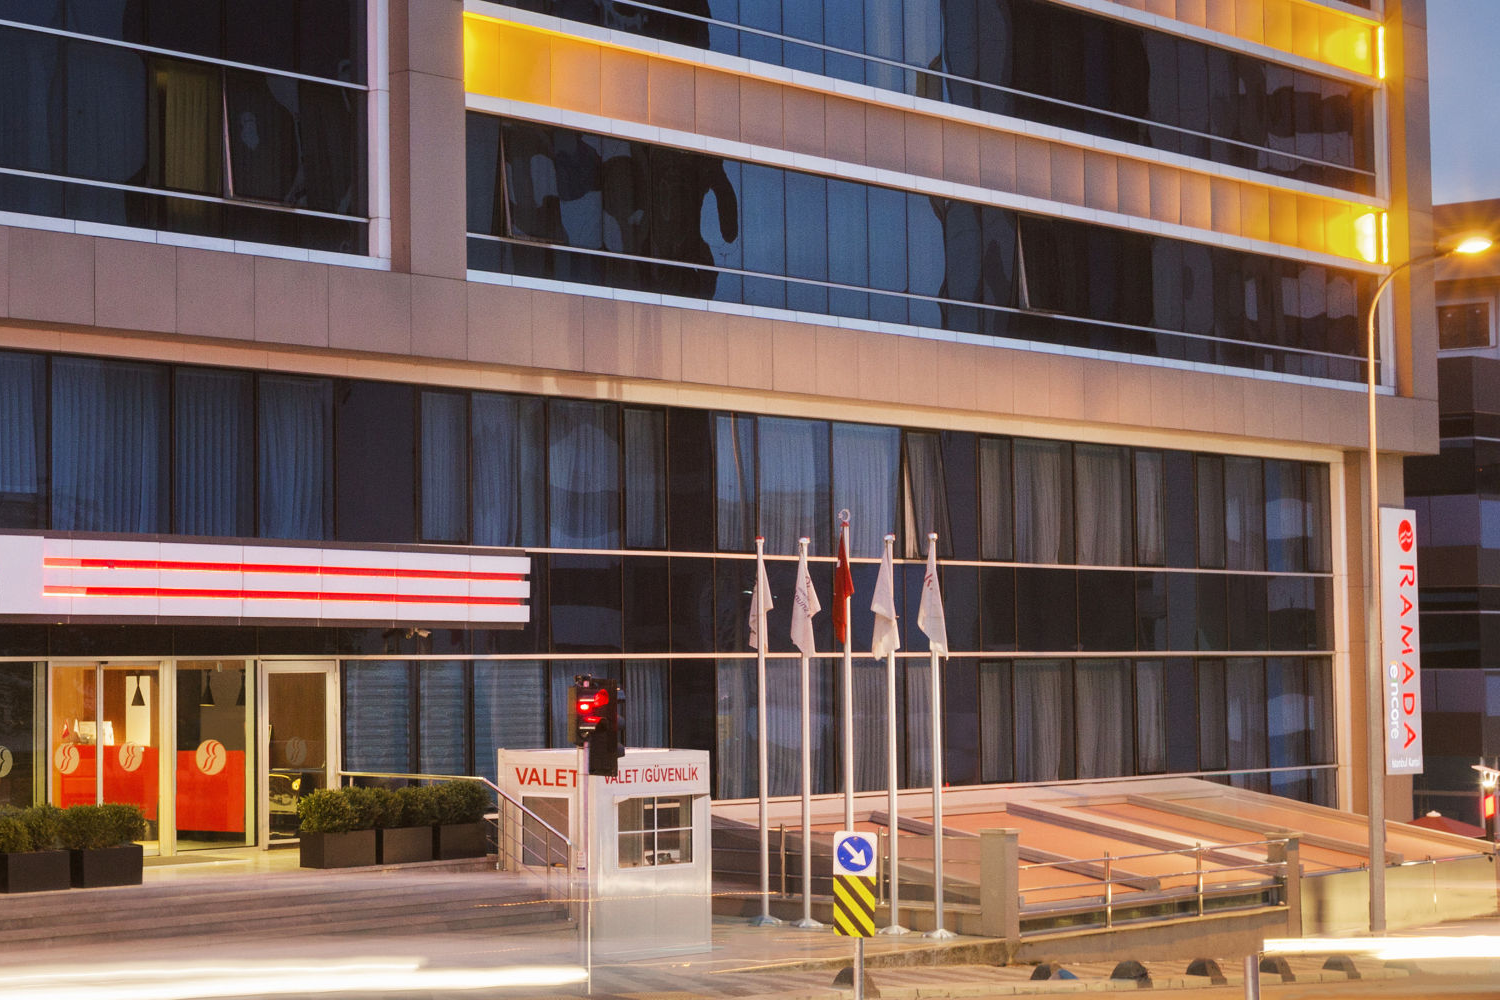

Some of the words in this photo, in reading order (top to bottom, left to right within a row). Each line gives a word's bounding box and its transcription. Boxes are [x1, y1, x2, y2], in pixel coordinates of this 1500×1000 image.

[1399, 564, 1417, 749] RAMADA
[1389, 660, 1400, 740] encore
[515, 767, 578, 788] VALET
